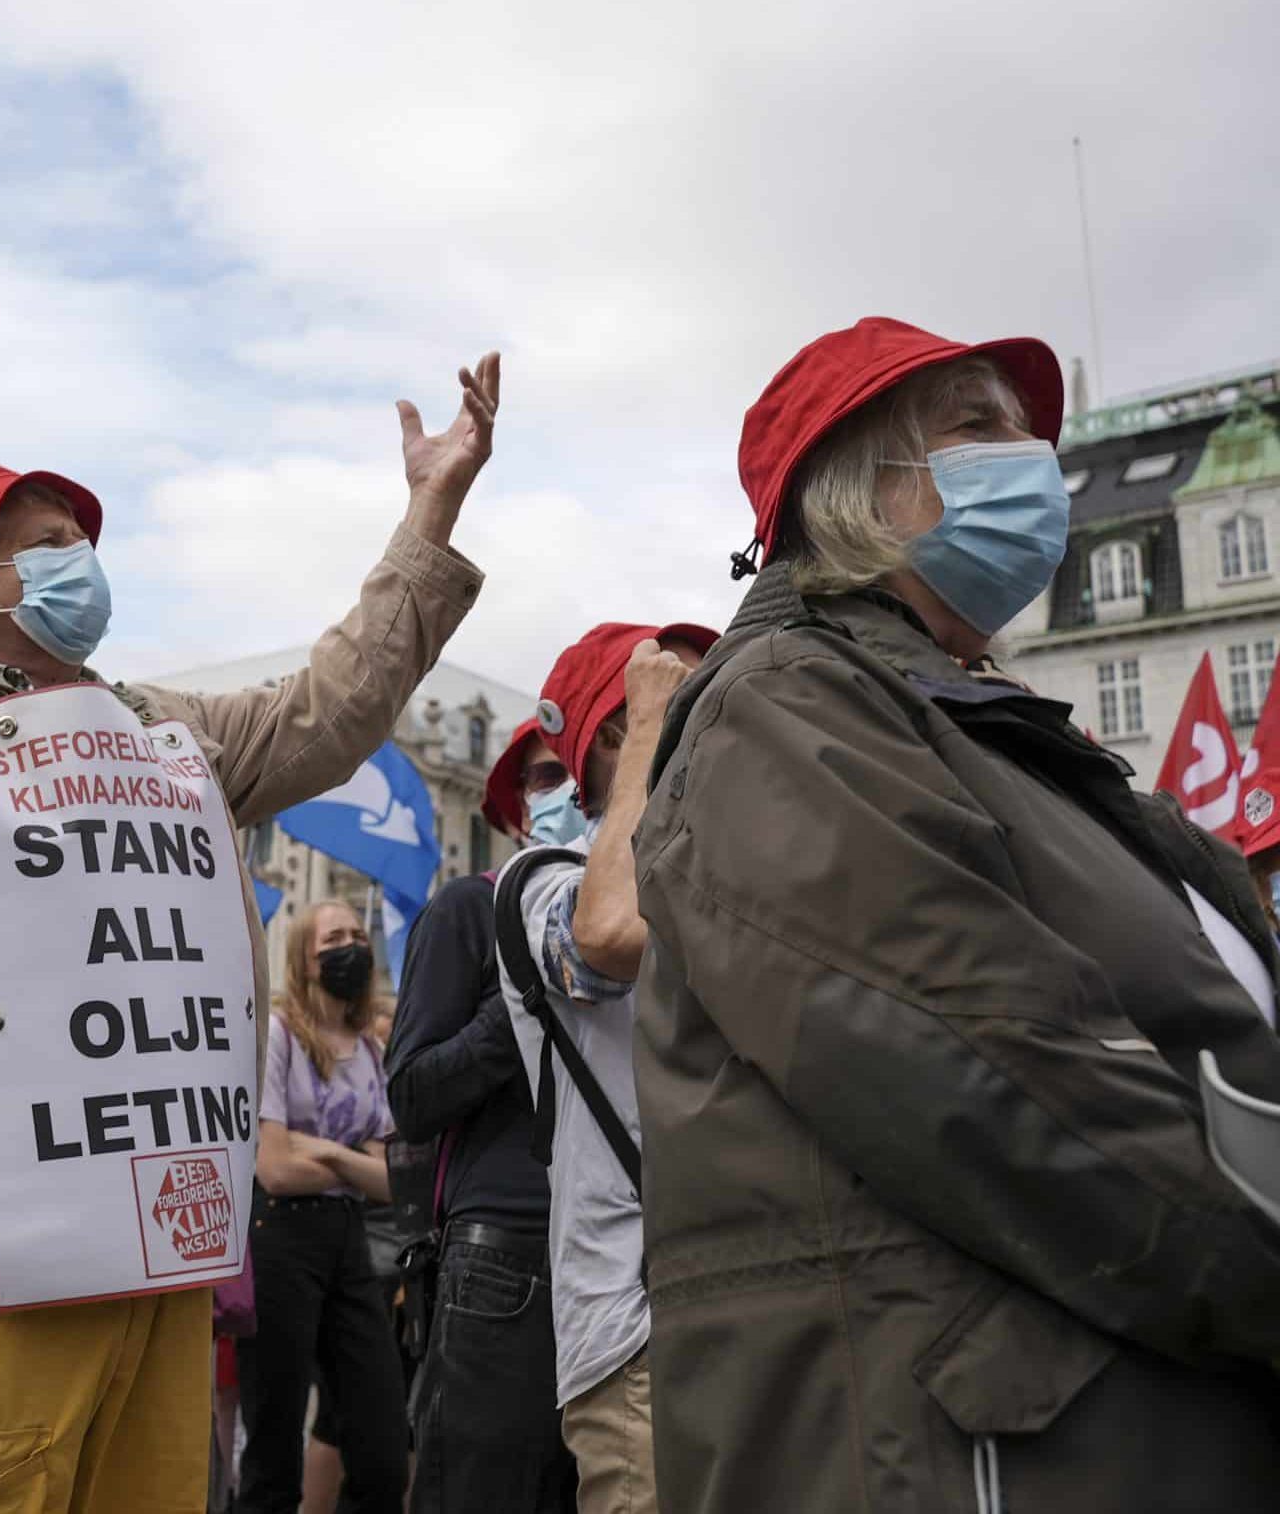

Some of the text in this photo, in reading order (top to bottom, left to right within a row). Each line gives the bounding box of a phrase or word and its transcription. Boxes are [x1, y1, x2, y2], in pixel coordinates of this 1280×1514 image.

[9, 775, 202, 814] KLIMAAKSJON
[13, 820, 216, 879] STANS
[86, 907, 204, 964] ALL
[69, 996, 231, 1059] OLJE
[31, 1086, 251, 1162] LETING
[158, 1180, 226, 1209] FORELDRENES
[159, 1200, 231, 1240] KLIMA
